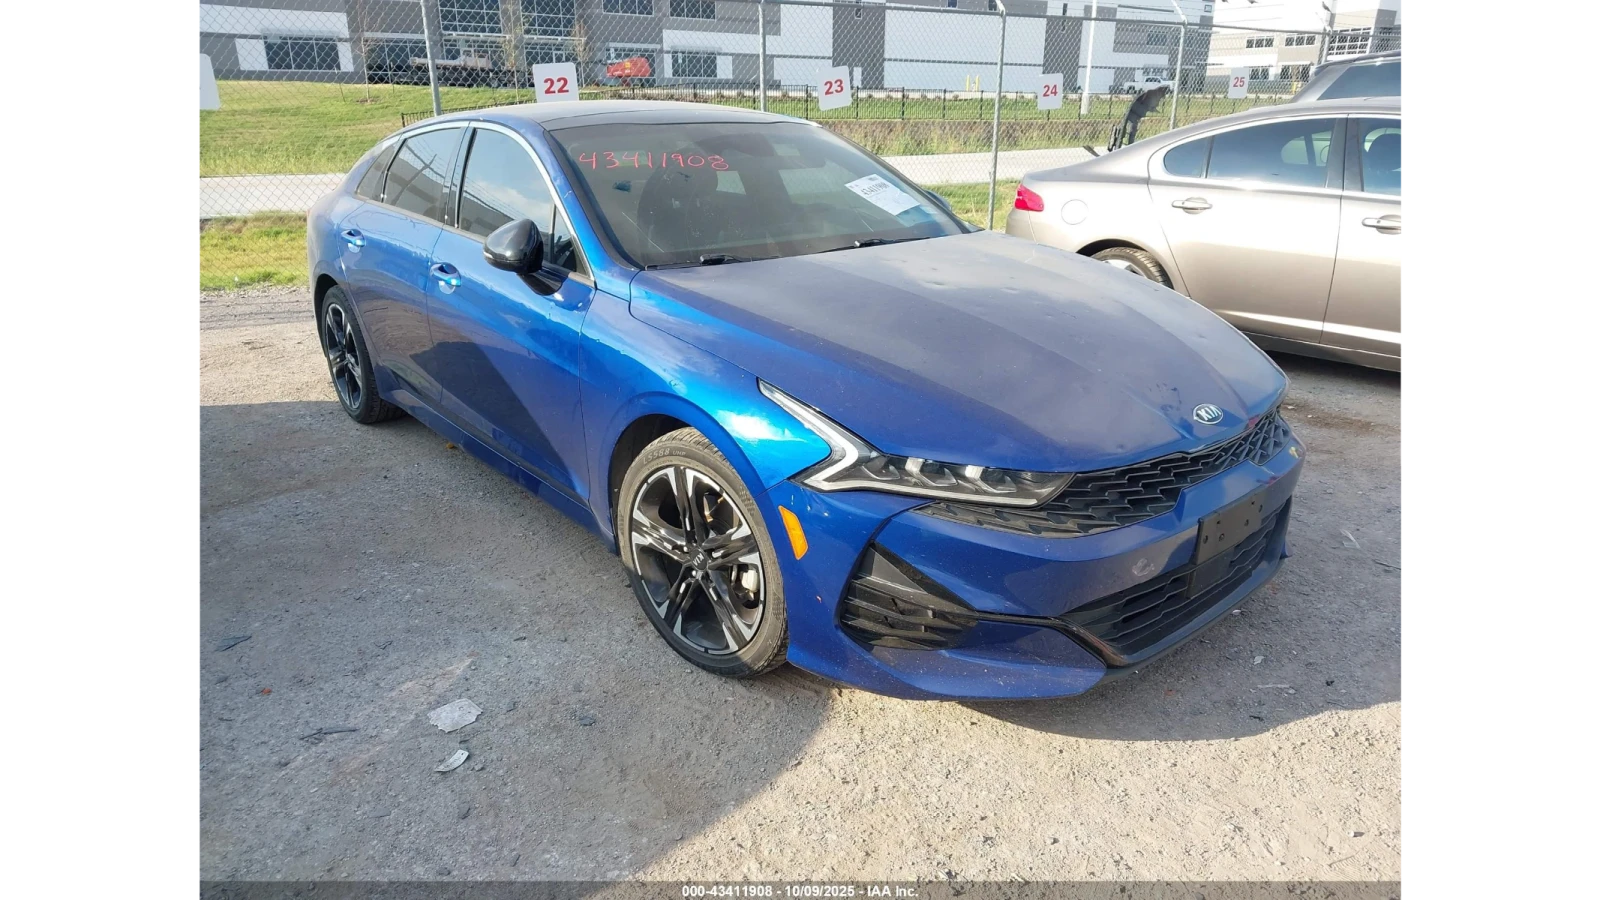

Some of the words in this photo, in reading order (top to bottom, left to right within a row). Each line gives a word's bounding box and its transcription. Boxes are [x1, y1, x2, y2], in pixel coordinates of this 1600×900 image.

[543, 77, 569, 95] 22
[824, 79, 844, 96] 23
[1232, 76, 1246, 88] 25
[1042, 84, 1058, 97] 24
[579, 151, 729, 170] 43411908
[1197, 406, 1221, 421] KIA
